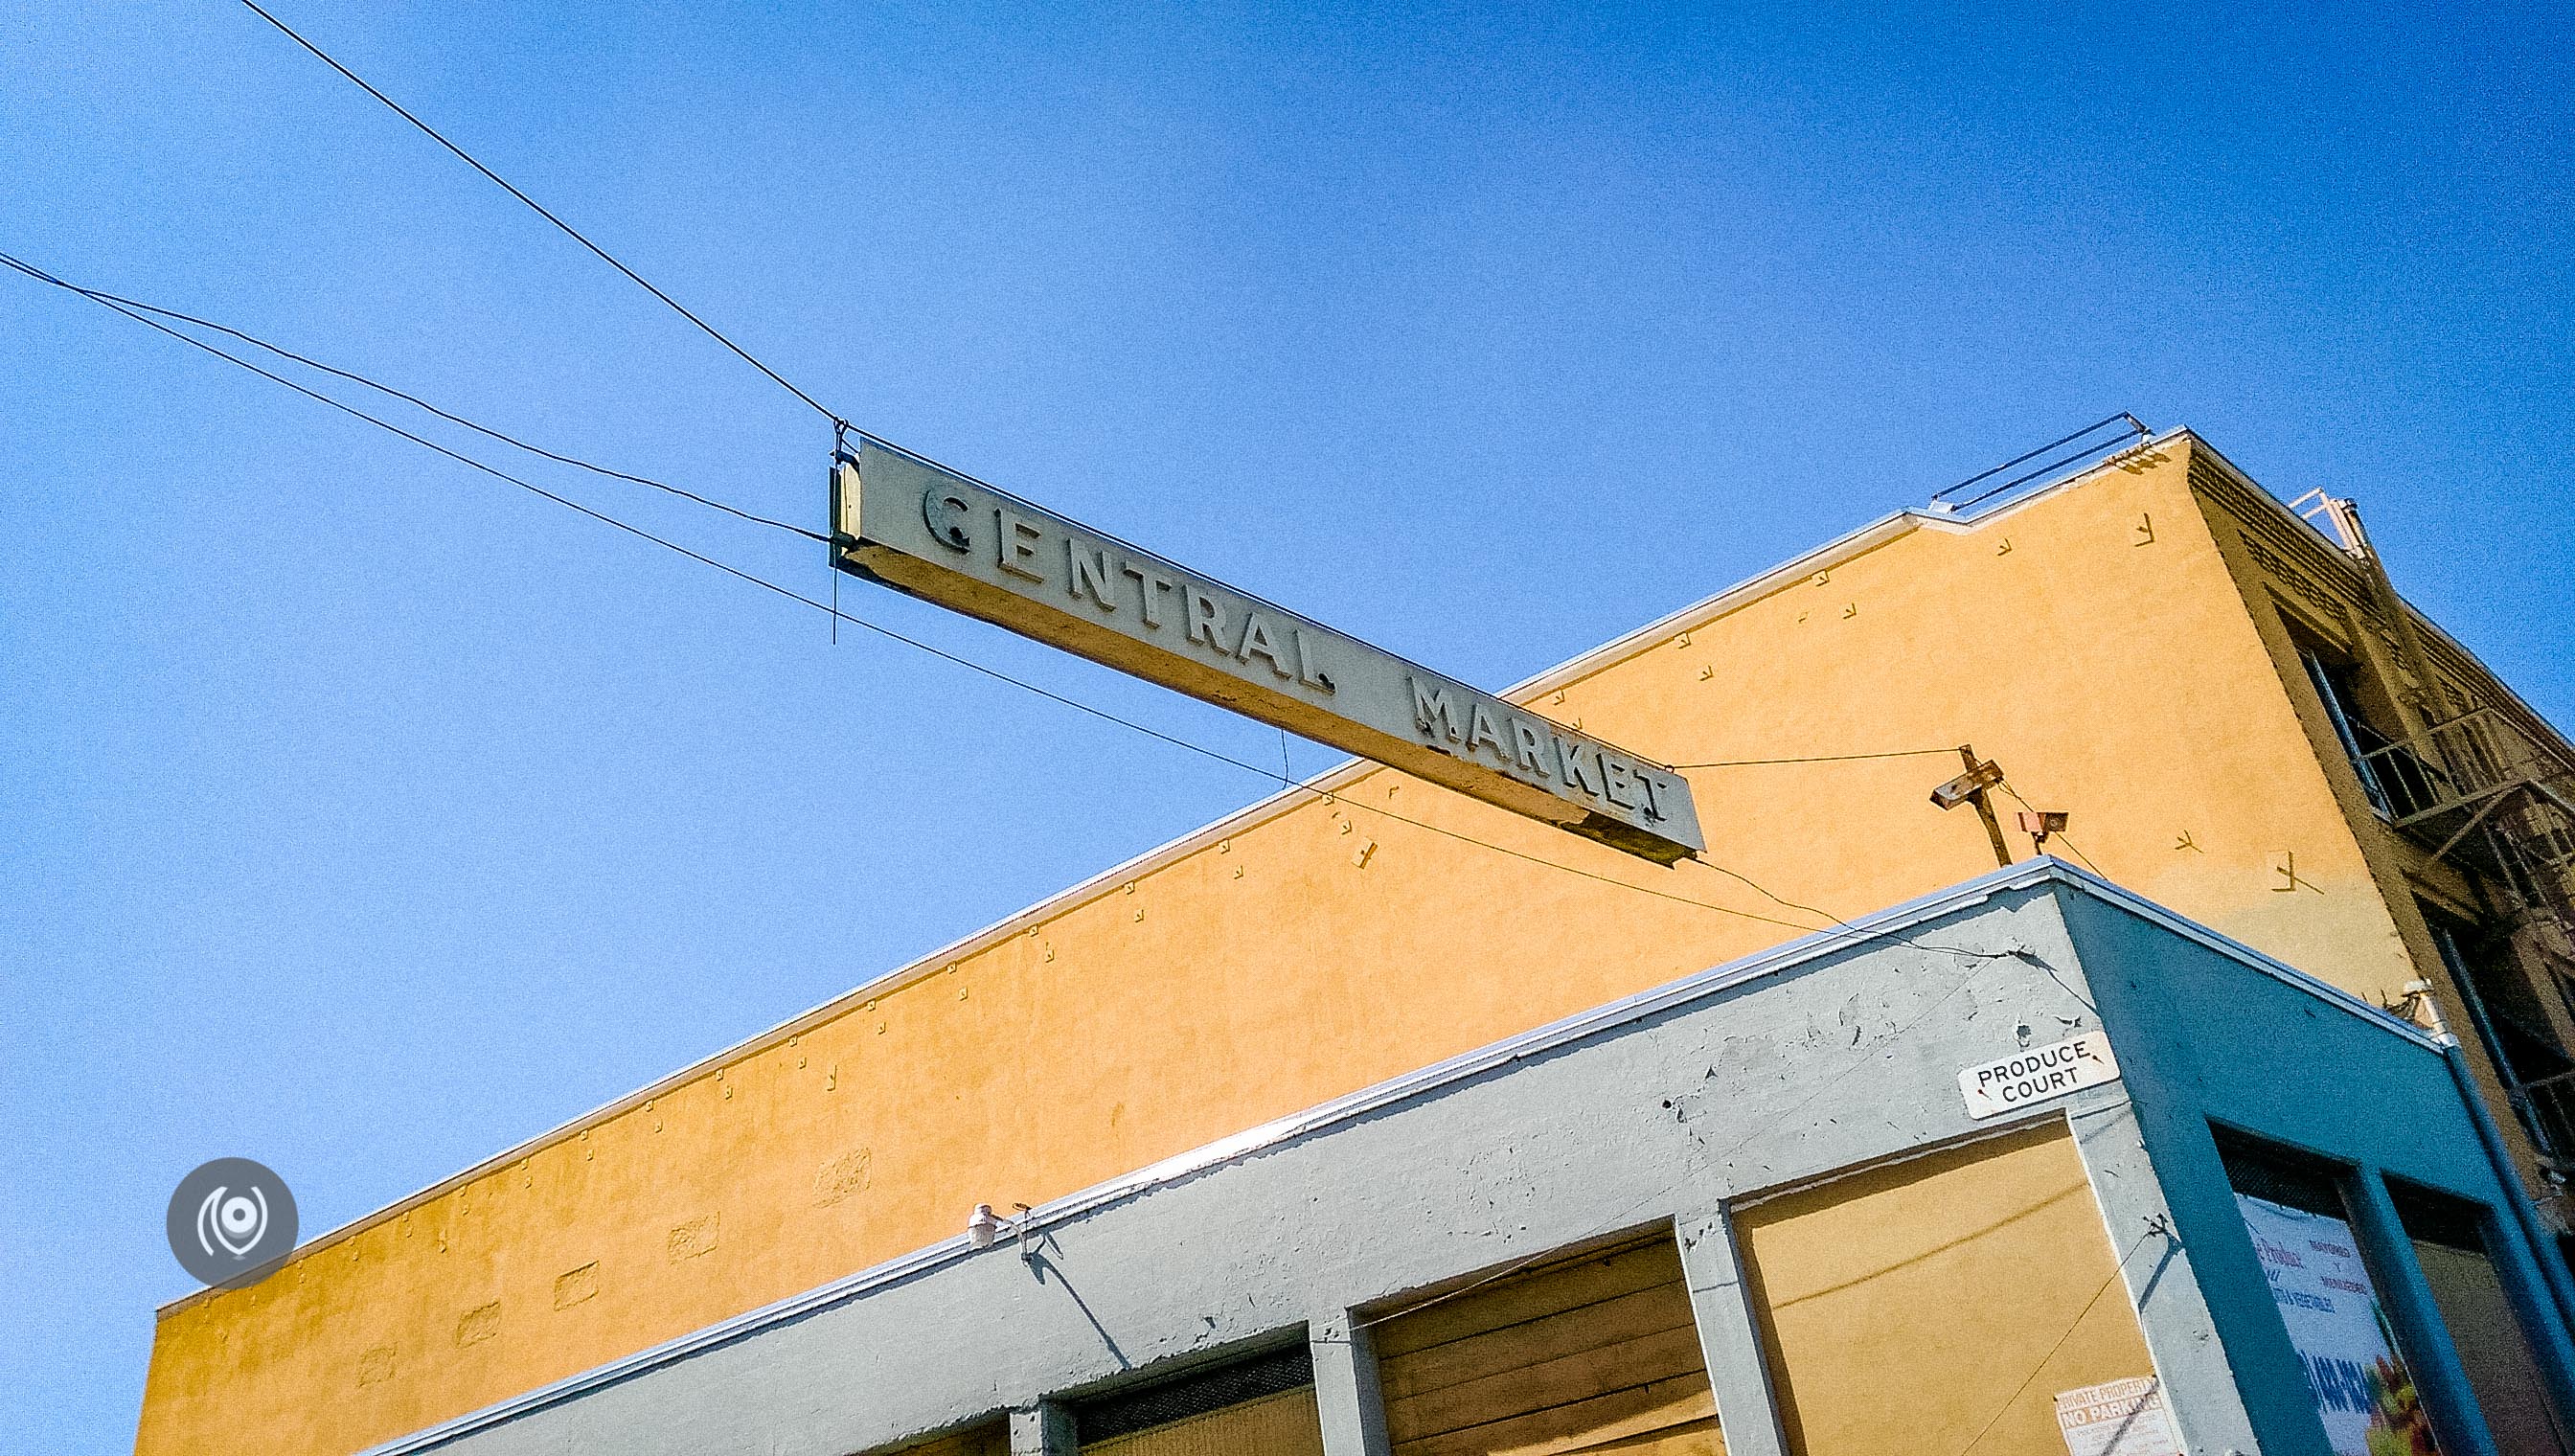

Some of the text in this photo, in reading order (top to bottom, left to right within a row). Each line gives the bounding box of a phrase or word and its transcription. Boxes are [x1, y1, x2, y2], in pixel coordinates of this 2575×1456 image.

[923, 489, 1667, 822] CENTRAL MARKET
[1977, 1041, 2090, 1087] PRODUCE
[2002, 1067, 2078, 1103] COURT
[2099, 1377, 2156, 1400] PROPERTY
[2062, 1392, 2161, 1427] NO PARKING
